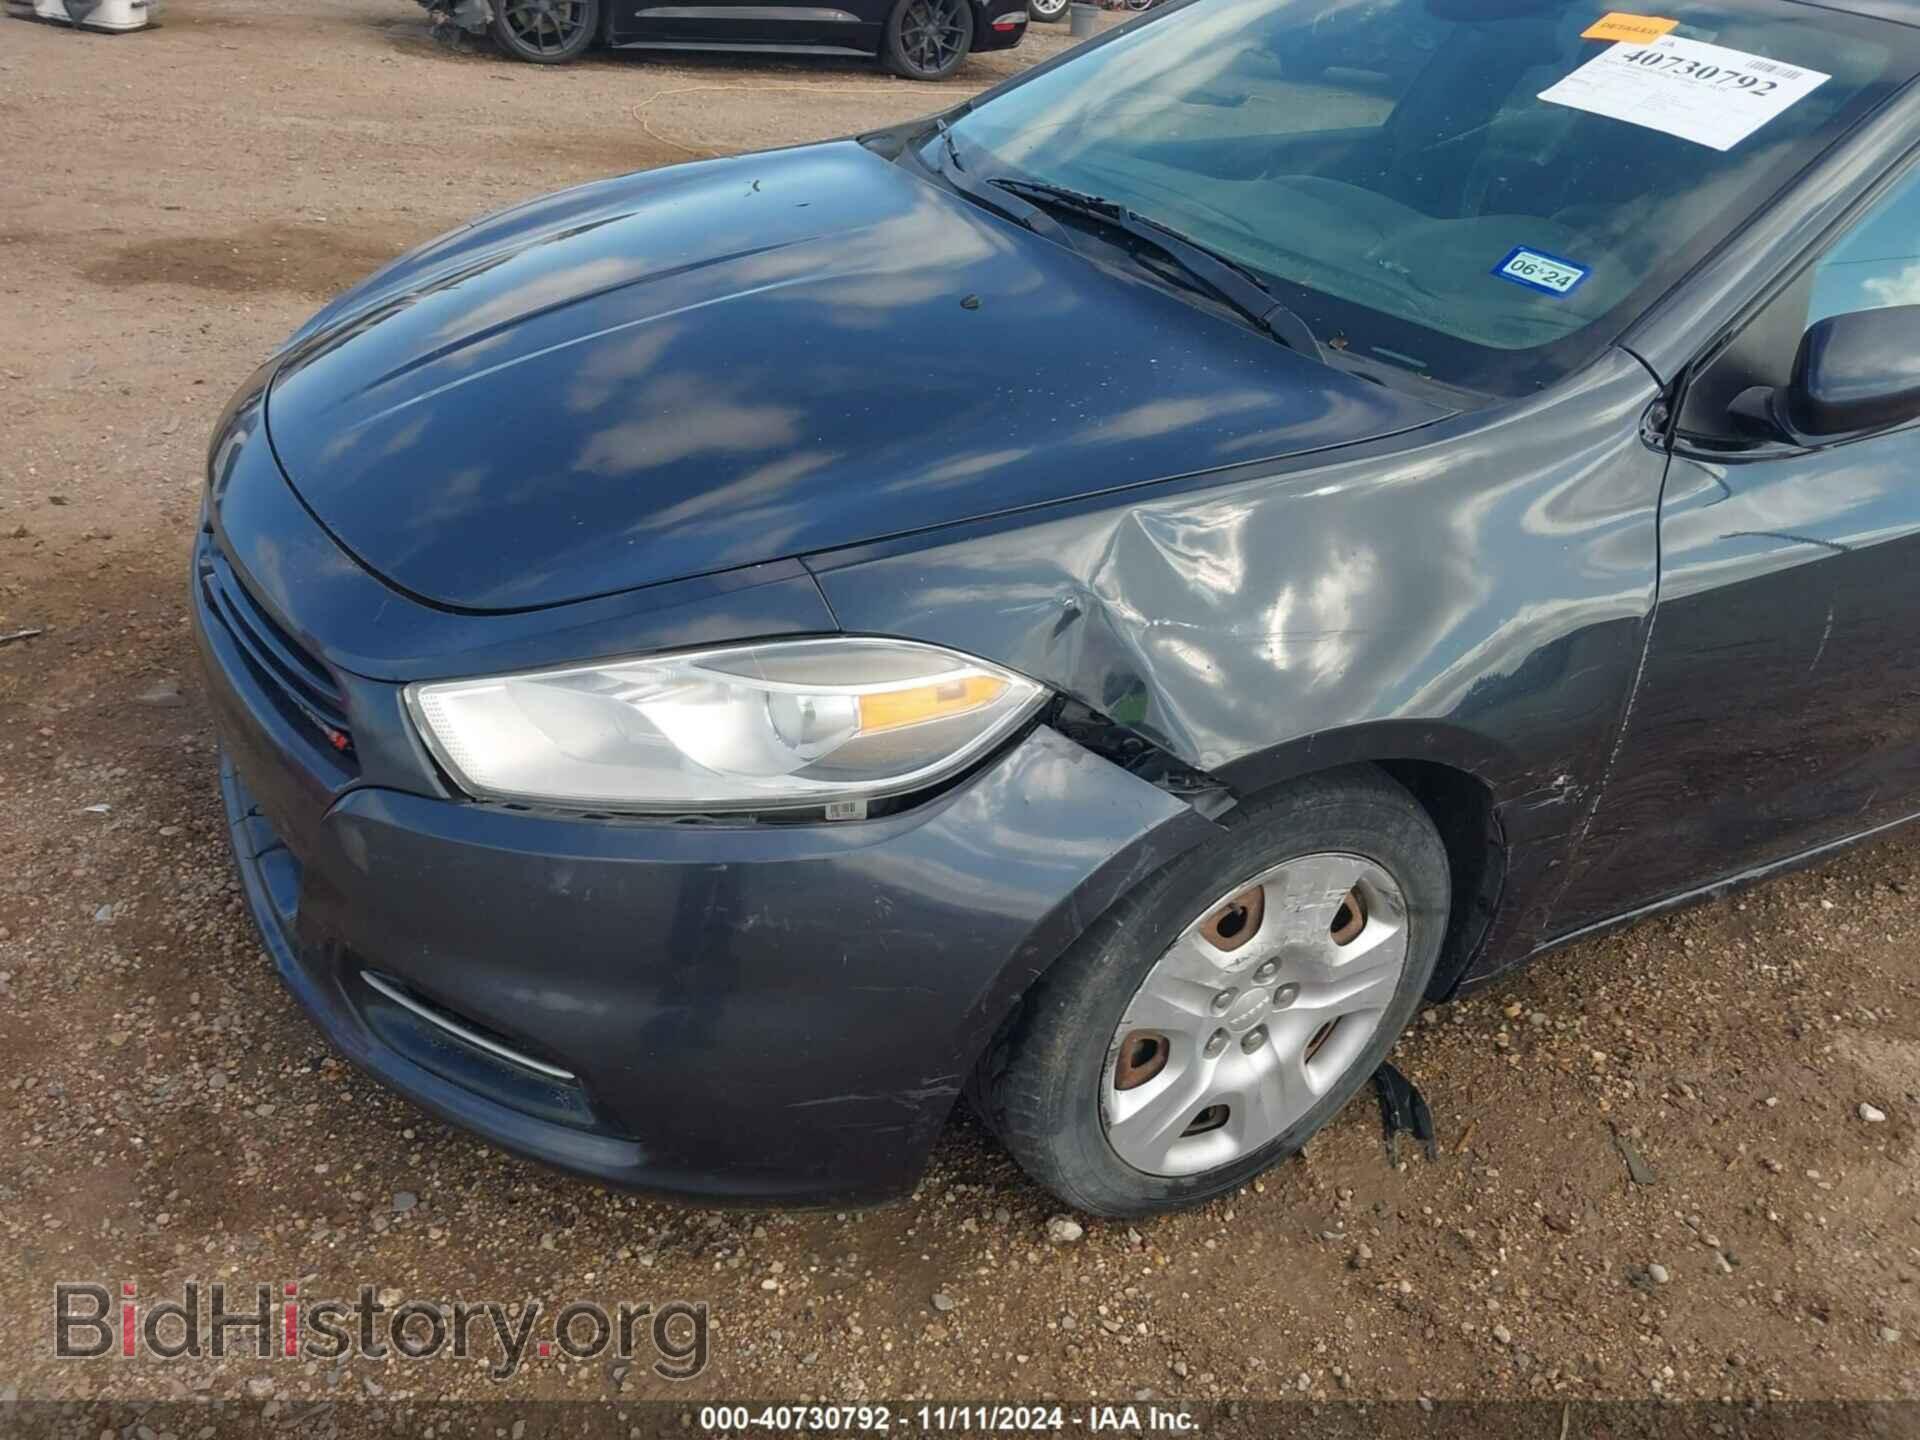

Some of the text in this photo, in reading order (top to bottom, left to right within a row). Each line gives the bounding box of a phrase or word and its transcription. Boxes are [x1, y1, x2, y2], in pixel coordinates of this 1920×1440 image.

[1623, 49, 1777, 97] 40730792
[1510, 260, 1538, 275] 06
[1541, 271, 1571, 287] 24
